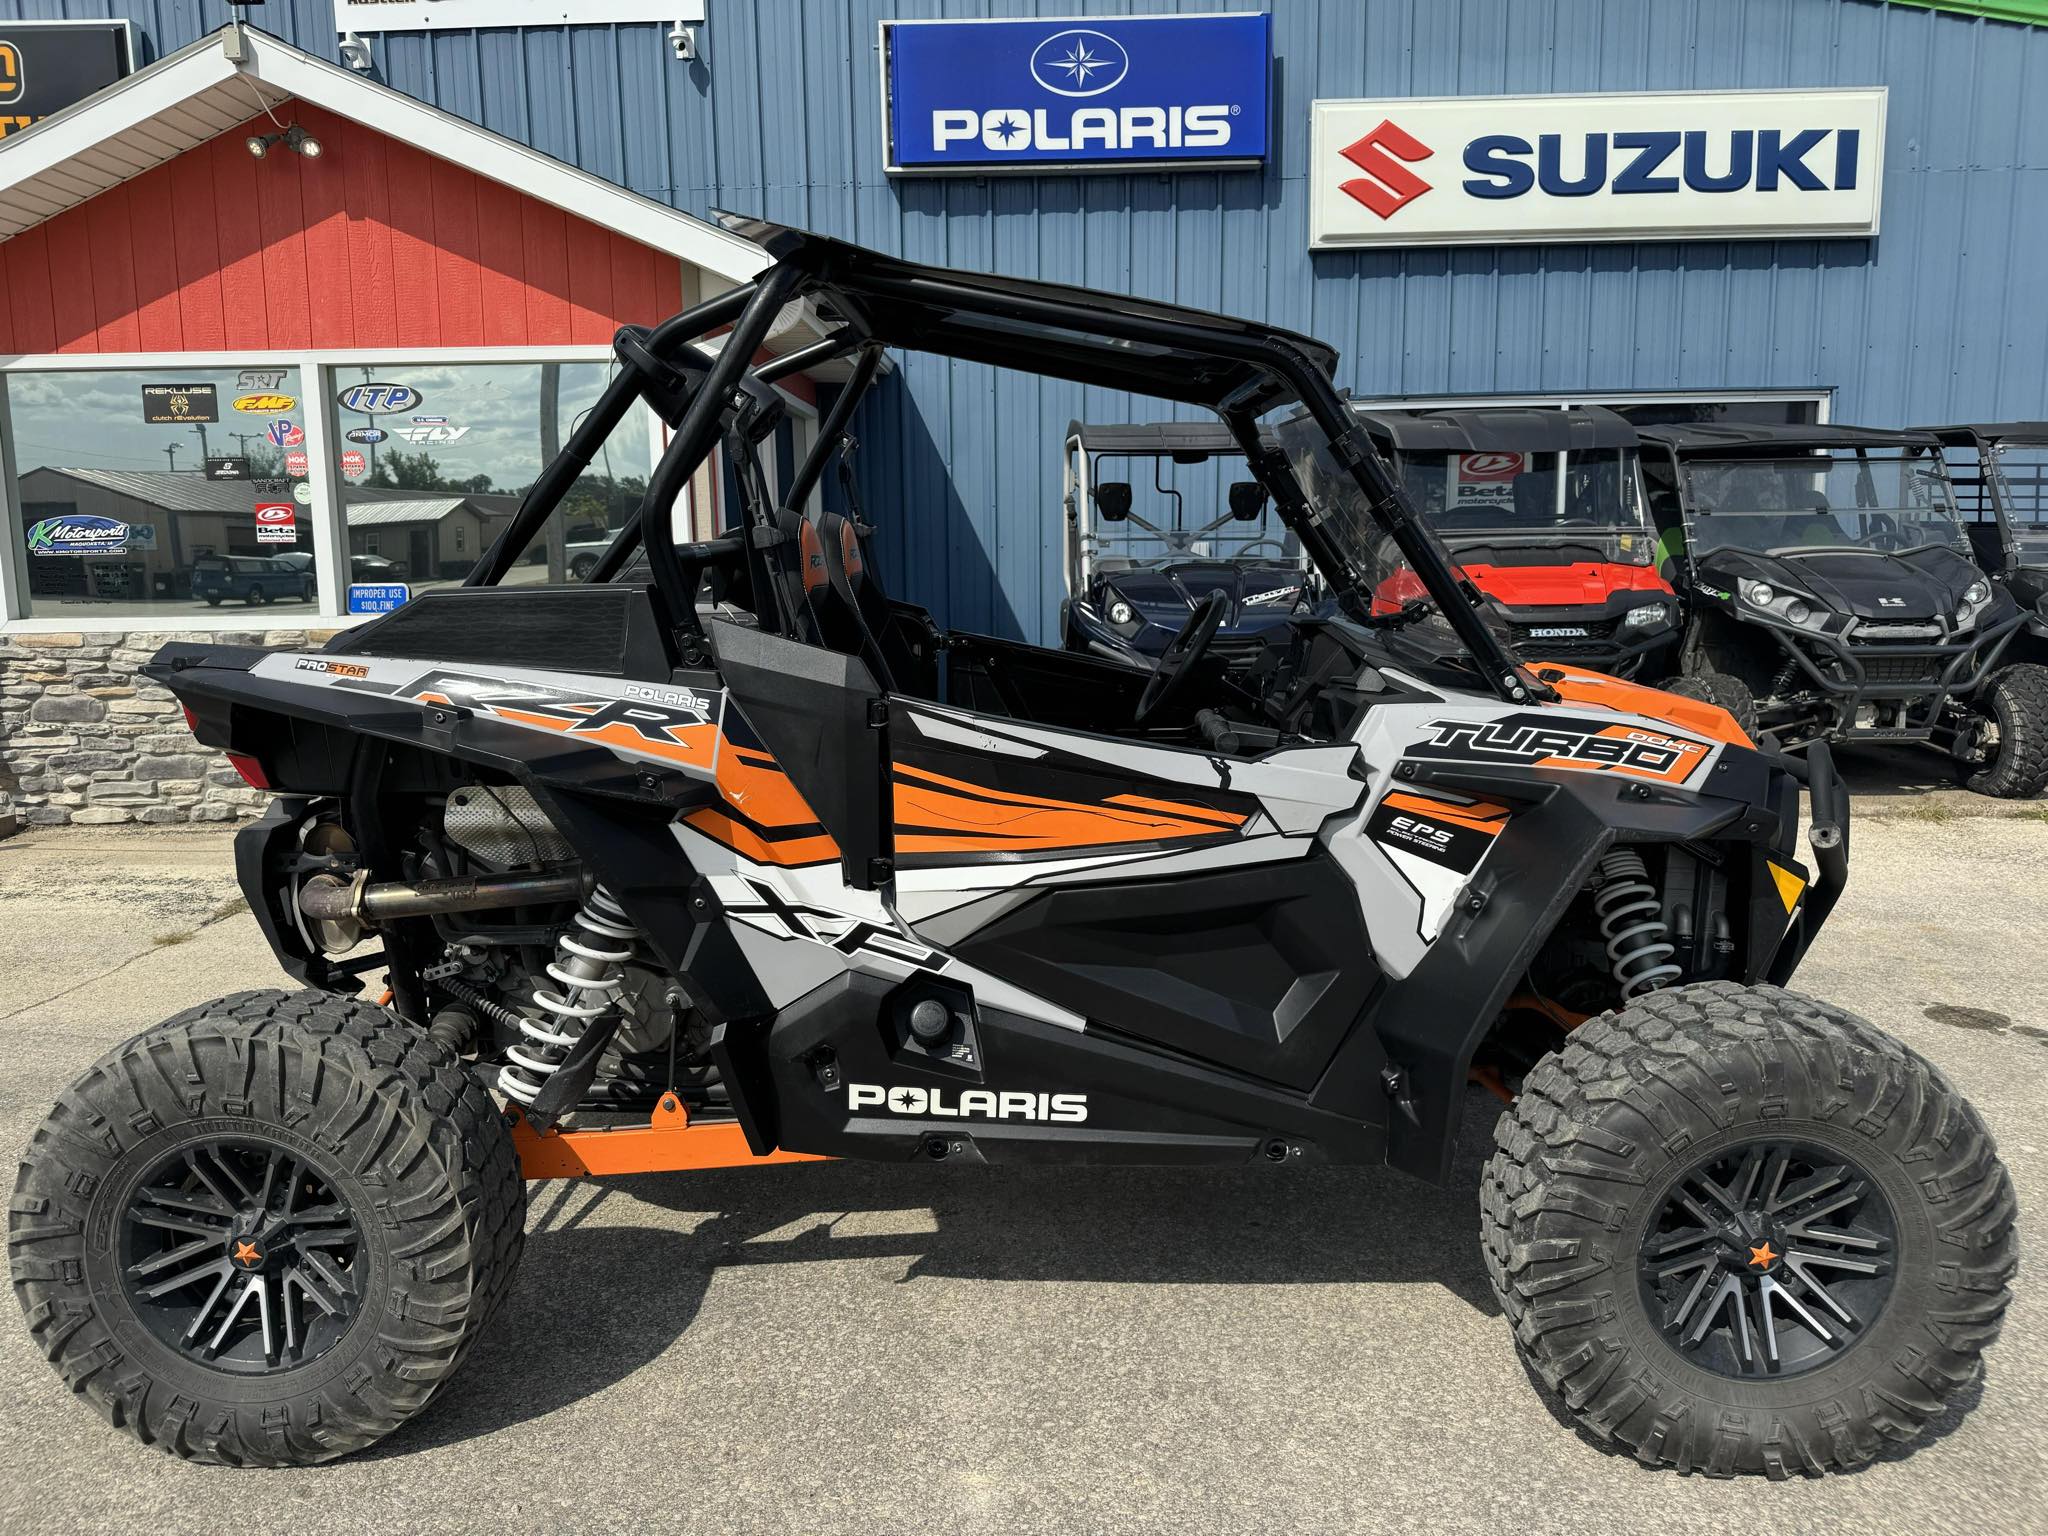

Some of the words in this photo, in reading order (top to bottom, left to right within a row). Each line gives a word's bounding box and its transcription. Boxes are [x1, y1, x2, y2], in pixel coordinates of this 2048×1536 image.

[1462, 128, 1860, 200] SUZUKI
[237, 370, 288, 391] SRT
[234, 396, 294, 410] FMF
[347, 386, 411, 410] ITP
[267, 419, 292, 446] VP
[393, 427, 471, 440] FLY
[48, 524, 125, 541] Motorsports
[353, 589, 385, 598] IMPROPER
[389, 589, 402, 598] USE
[361, 601, 377, 610] $100
[380, 601, 394, 610] FINE
[1529, 628, 1588, 637] HONDA
[624, 685, 710, 711] POLARIS
[1416, 719, 1682, 775] TURBO
[1627, 732, 1702, 754] DOHC
[1391, 816, 1455, 843] EPS
[1386, 830, 1413, 840] POWER
[1413, 838, 1447, 852] STEERING
[848, 1083, 1088, 1122] POLARIS
